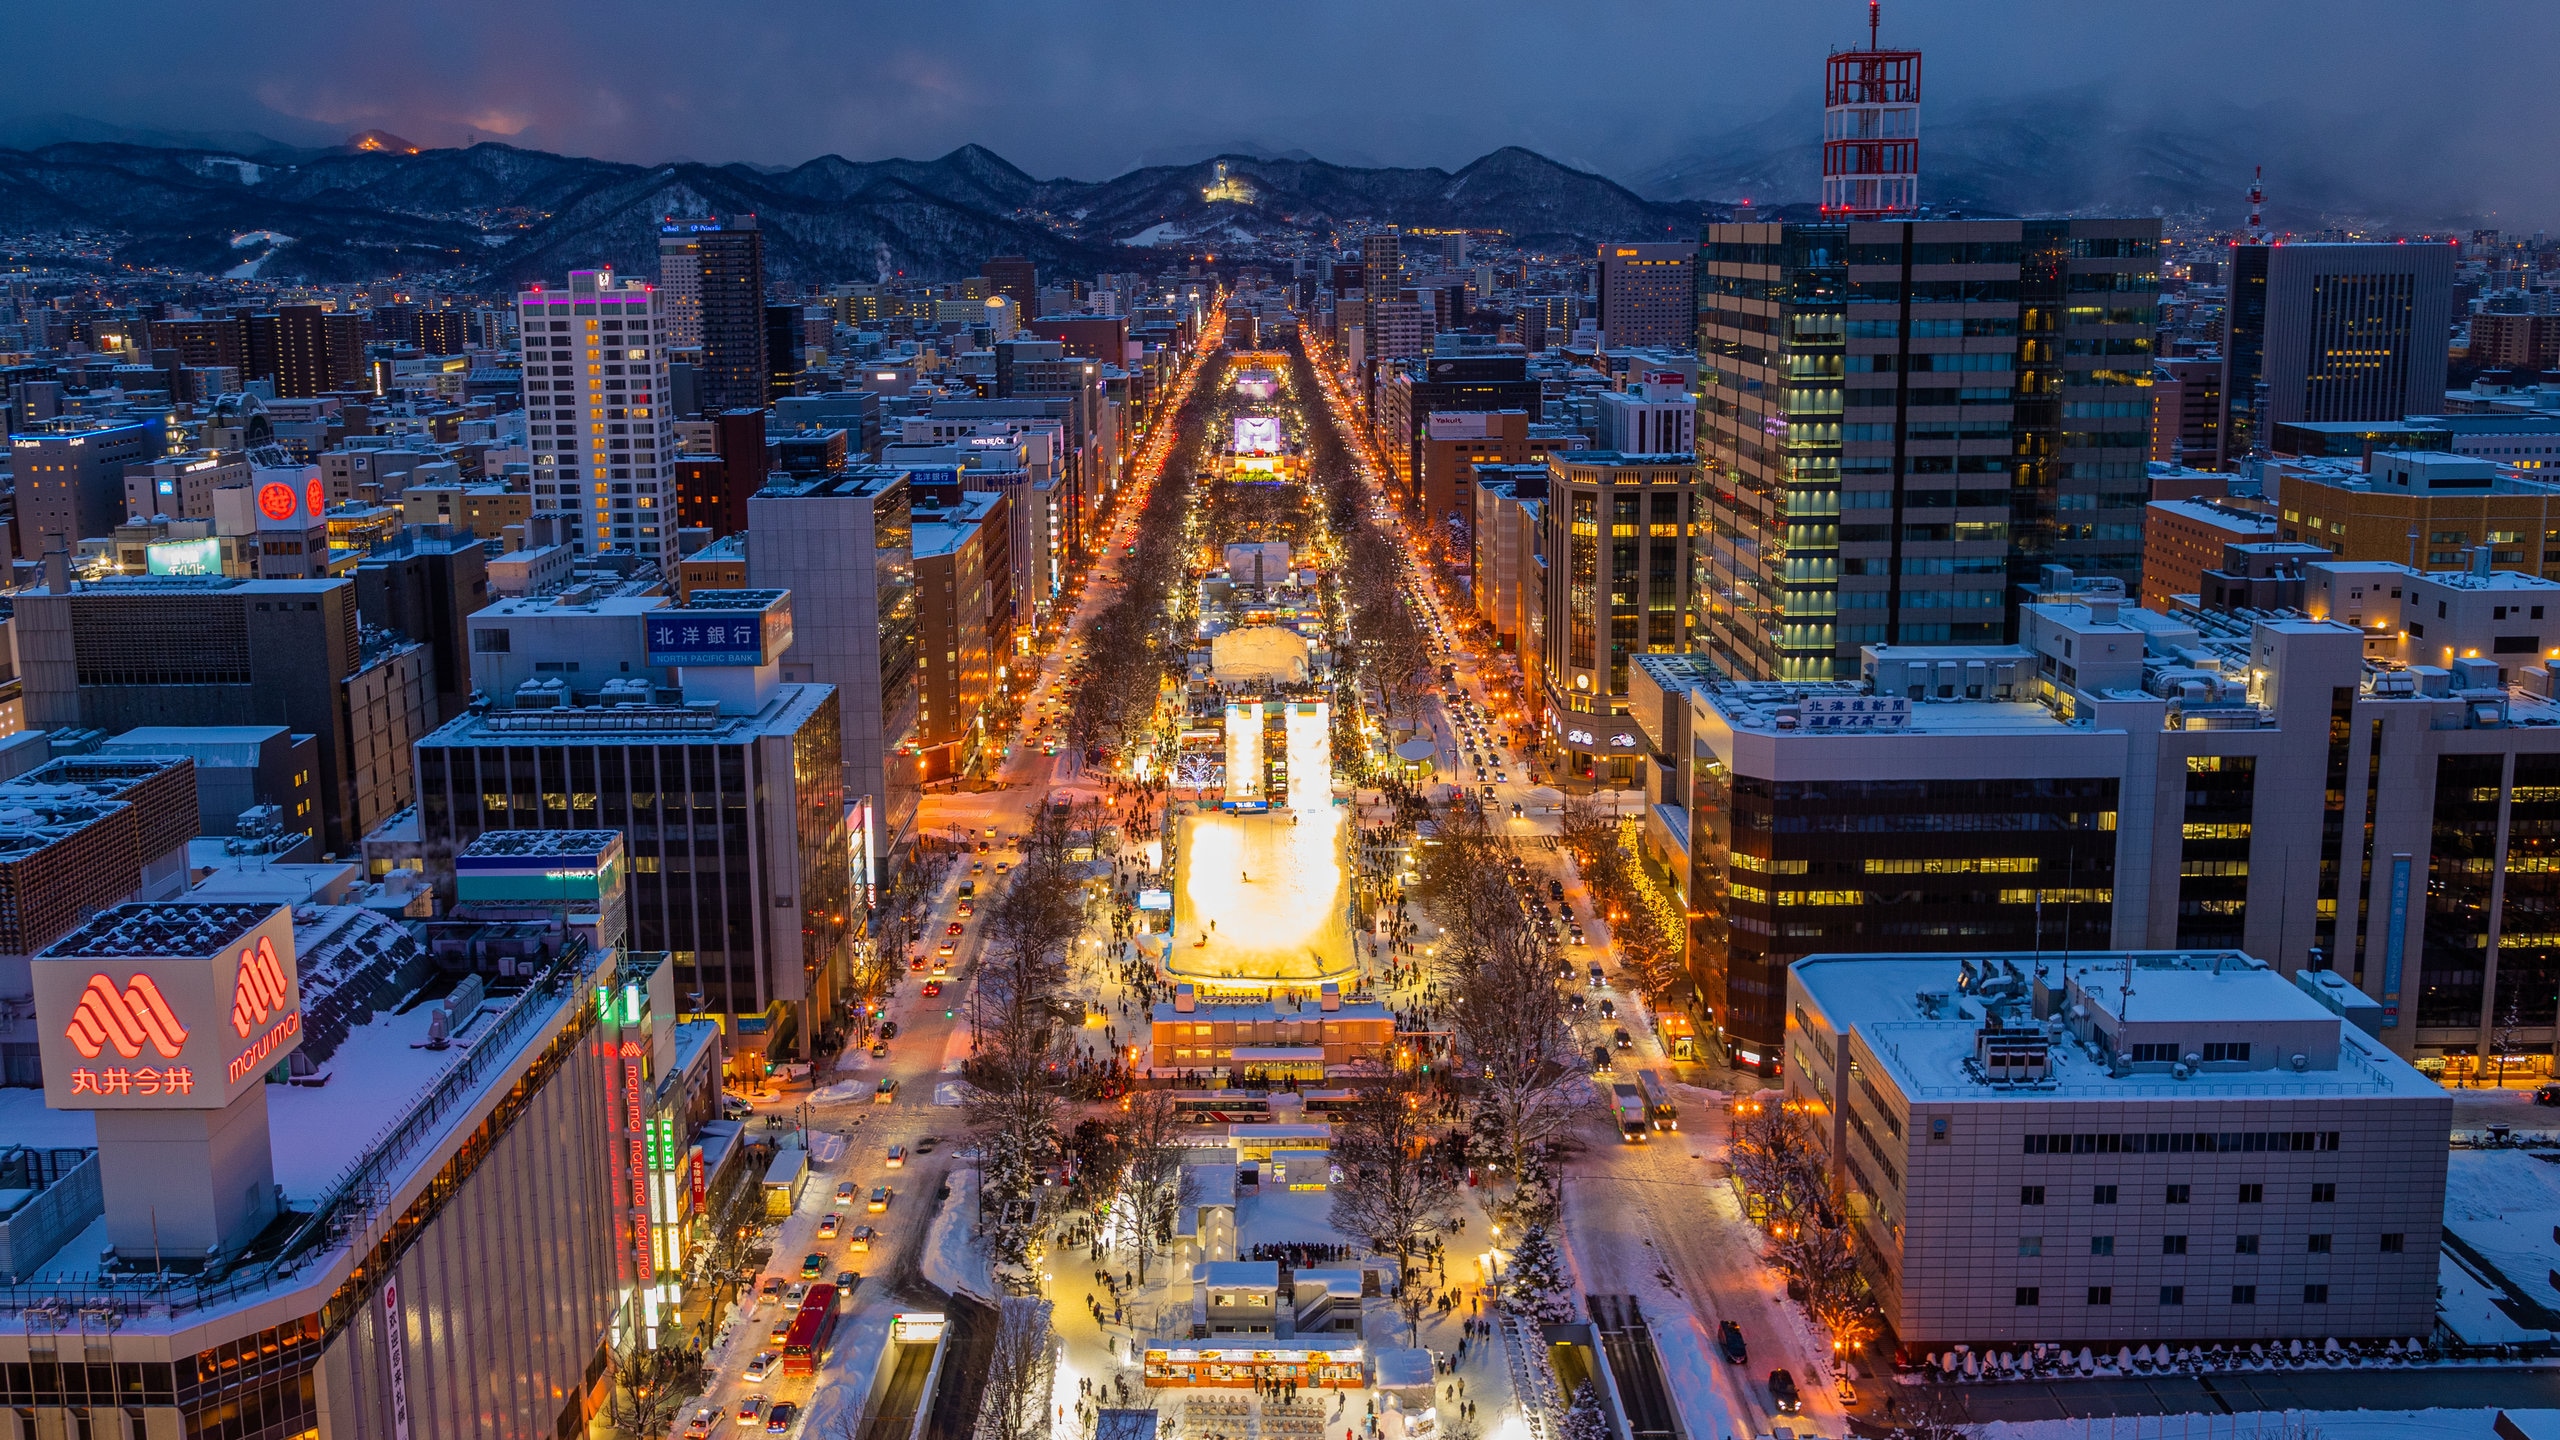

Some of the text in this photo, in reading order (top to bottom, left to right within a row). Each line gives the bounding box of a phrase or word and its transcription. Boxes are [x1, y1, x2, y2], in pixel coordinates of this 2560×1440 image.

[971, 438, 987, 446] HOTEL
[356, 459, 366, 469] P
[914, 472, 949, 482] 北洋銀行
[656, 625, 752, 646] 北洋銀行
[657, 653, 753, 664] NORTH PACIFIC BANK
[1809, 699, 1905, 712] 北海道新聞
[1809, 714, 1905, 726] 道新スポーツ
[70, 1066, 195, 1096] 丸井今井
[693, 1161, 703, 1193] 北陸銀行
